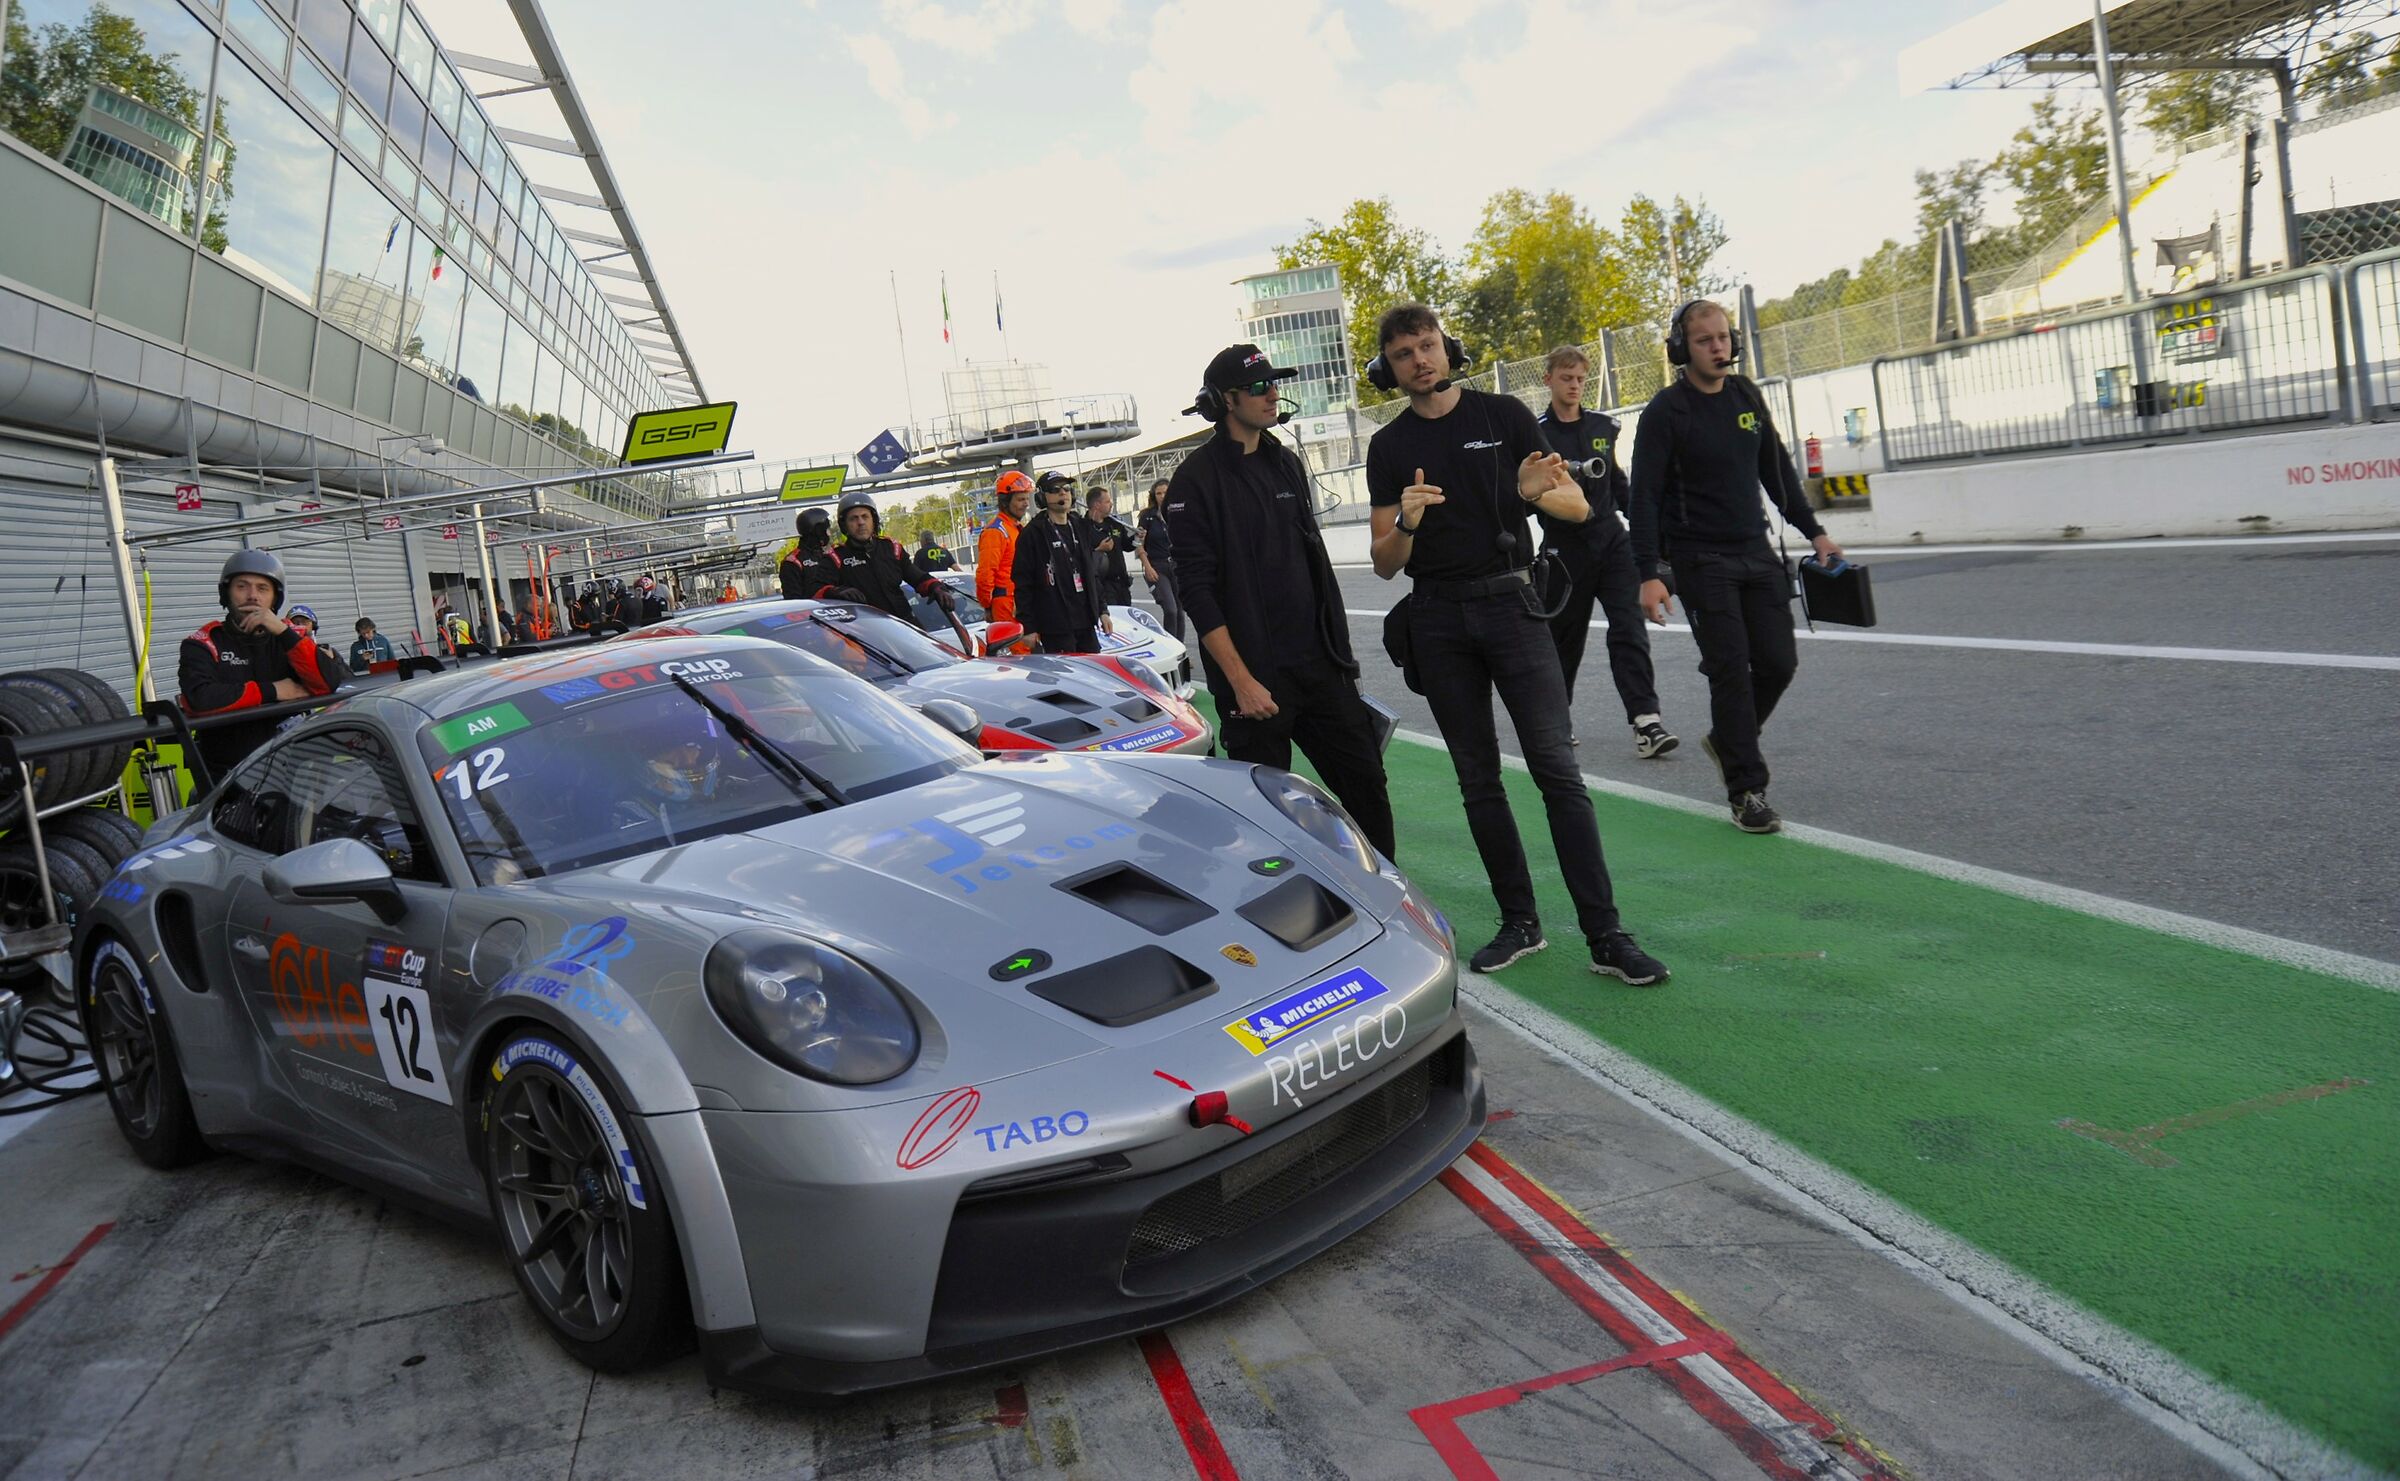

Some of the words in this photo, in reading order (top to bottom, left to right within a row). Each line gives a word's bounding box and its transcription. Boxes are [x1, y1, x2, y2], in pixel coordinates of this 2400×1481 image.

[641, 421, 718, 446] GSP
[789, 476, 837, 492] GSP
[2287, 466, 2315, 485] NO
[177, 488, 200, 504] 24
[384, 519, 400, 529] 22
[442, 526, 457, 536] 21
[812, 608, 848, 617] Cup
[596, 665, 658, 689] GT
[659, 656, 731, 677] Cup
[683, 669, 744, 685] Europe
[467, 716, 498, 736] AM
[1122, 728, 1175, 751] MICHELIN
[446, 747, 510, 800] 12
[402, 950, 426, 978] Cup
[400, 974, 423, 988] Europe
[1279, 980, 1364, 1026] MICHELIN
[379, 994, 435, 1083] 12
[507, 1041, 569, 1071] MICHELIN
[1263, 1003, 1407, 1109] RELECO
[576, 1075, 597, 1101] PILOT
[595, 1102, 618, 1140] SPORT
[974, 1110, 1090, 1153] TABO
